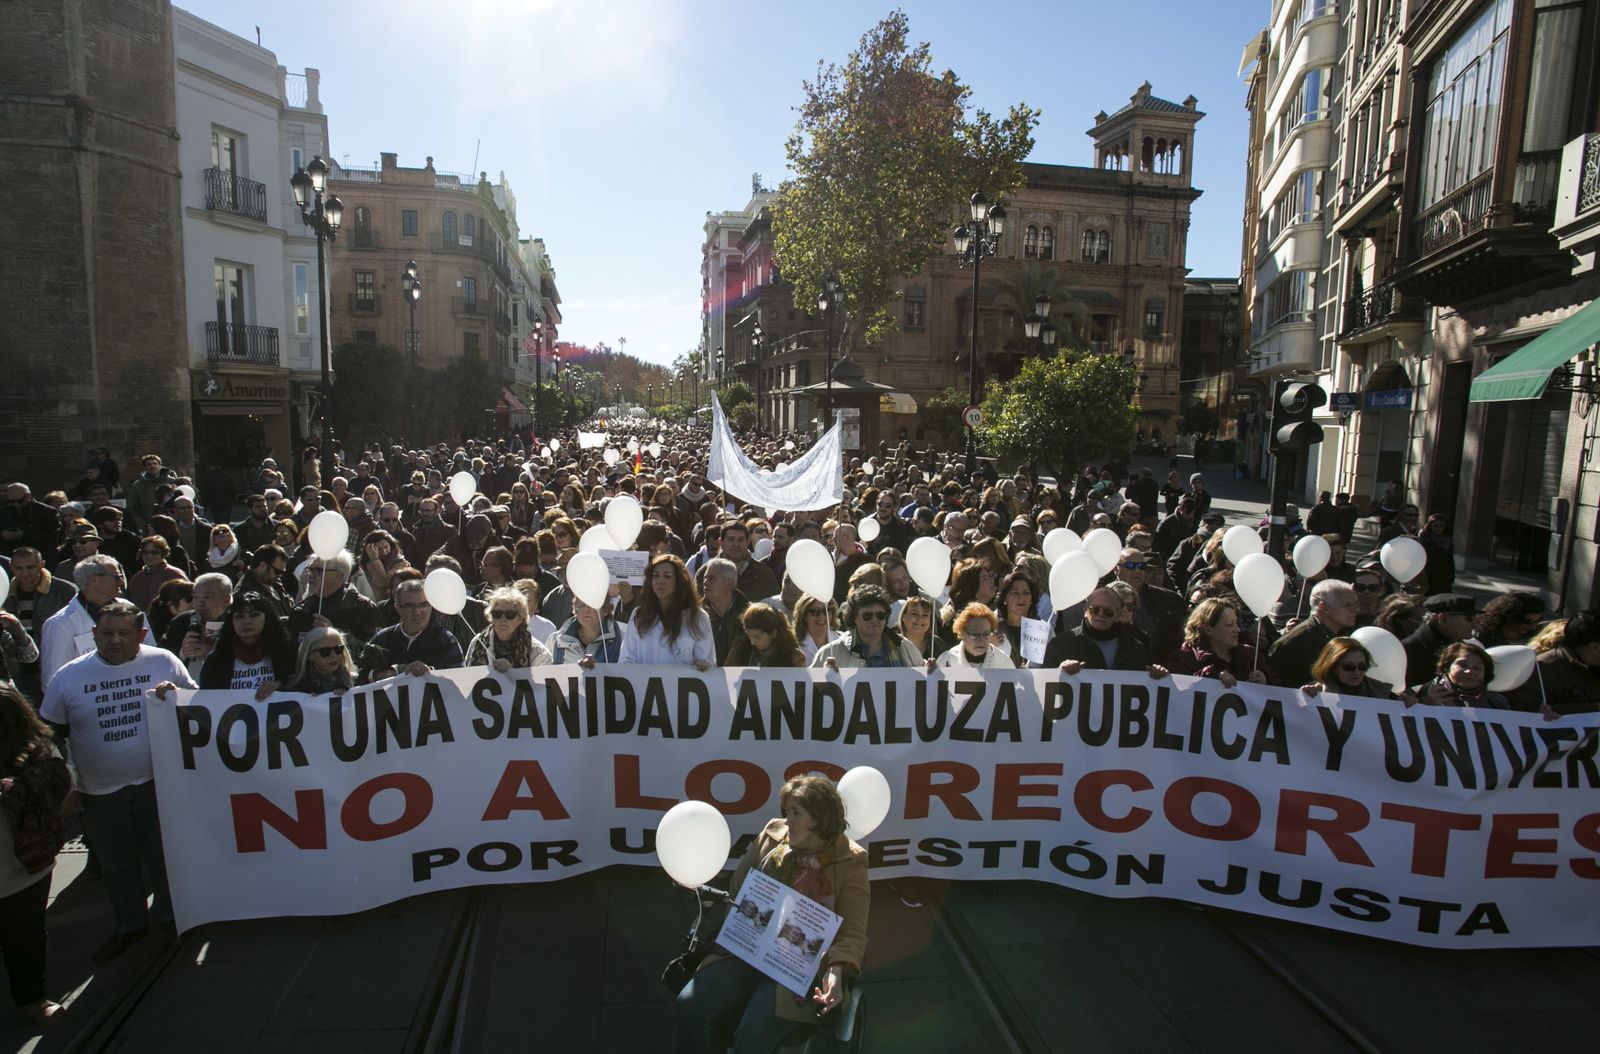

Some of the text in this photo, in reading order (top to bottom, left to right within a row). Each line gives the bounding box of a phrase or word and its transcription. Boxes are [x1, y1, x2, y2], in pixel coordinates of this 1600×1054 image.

[222, 379, 286, 397] Amorino
[968, 413, 980, 422] 10
[84, 674, 151, 694] La Sierra Sur
[95, 688, 142, 704] en lucha
[97, 701, 141, 717] por una
[99, 712, 141, 729] sanidad
[175, 703, 309, 773] POR
[329, 683, 455, 762] UNA
[471, 676, 711, 740] SANIDAD
[728, 679, 1022, 745] ANDALUZA
[1040, 681, 1291, 765] PUBLICA
[1316, 706, 1356, 772] Y
[104, 726, 138, 743] digna!
[230, 772, 434, 853] NO
[482, 760, 570, 821] A
[613, 753, 848, 816] LO
[412, 840, 583, 883] POR
[867, 838, 1166, 886] ESTIÓN
[1197, 864, 1511, 937] JUSTA
